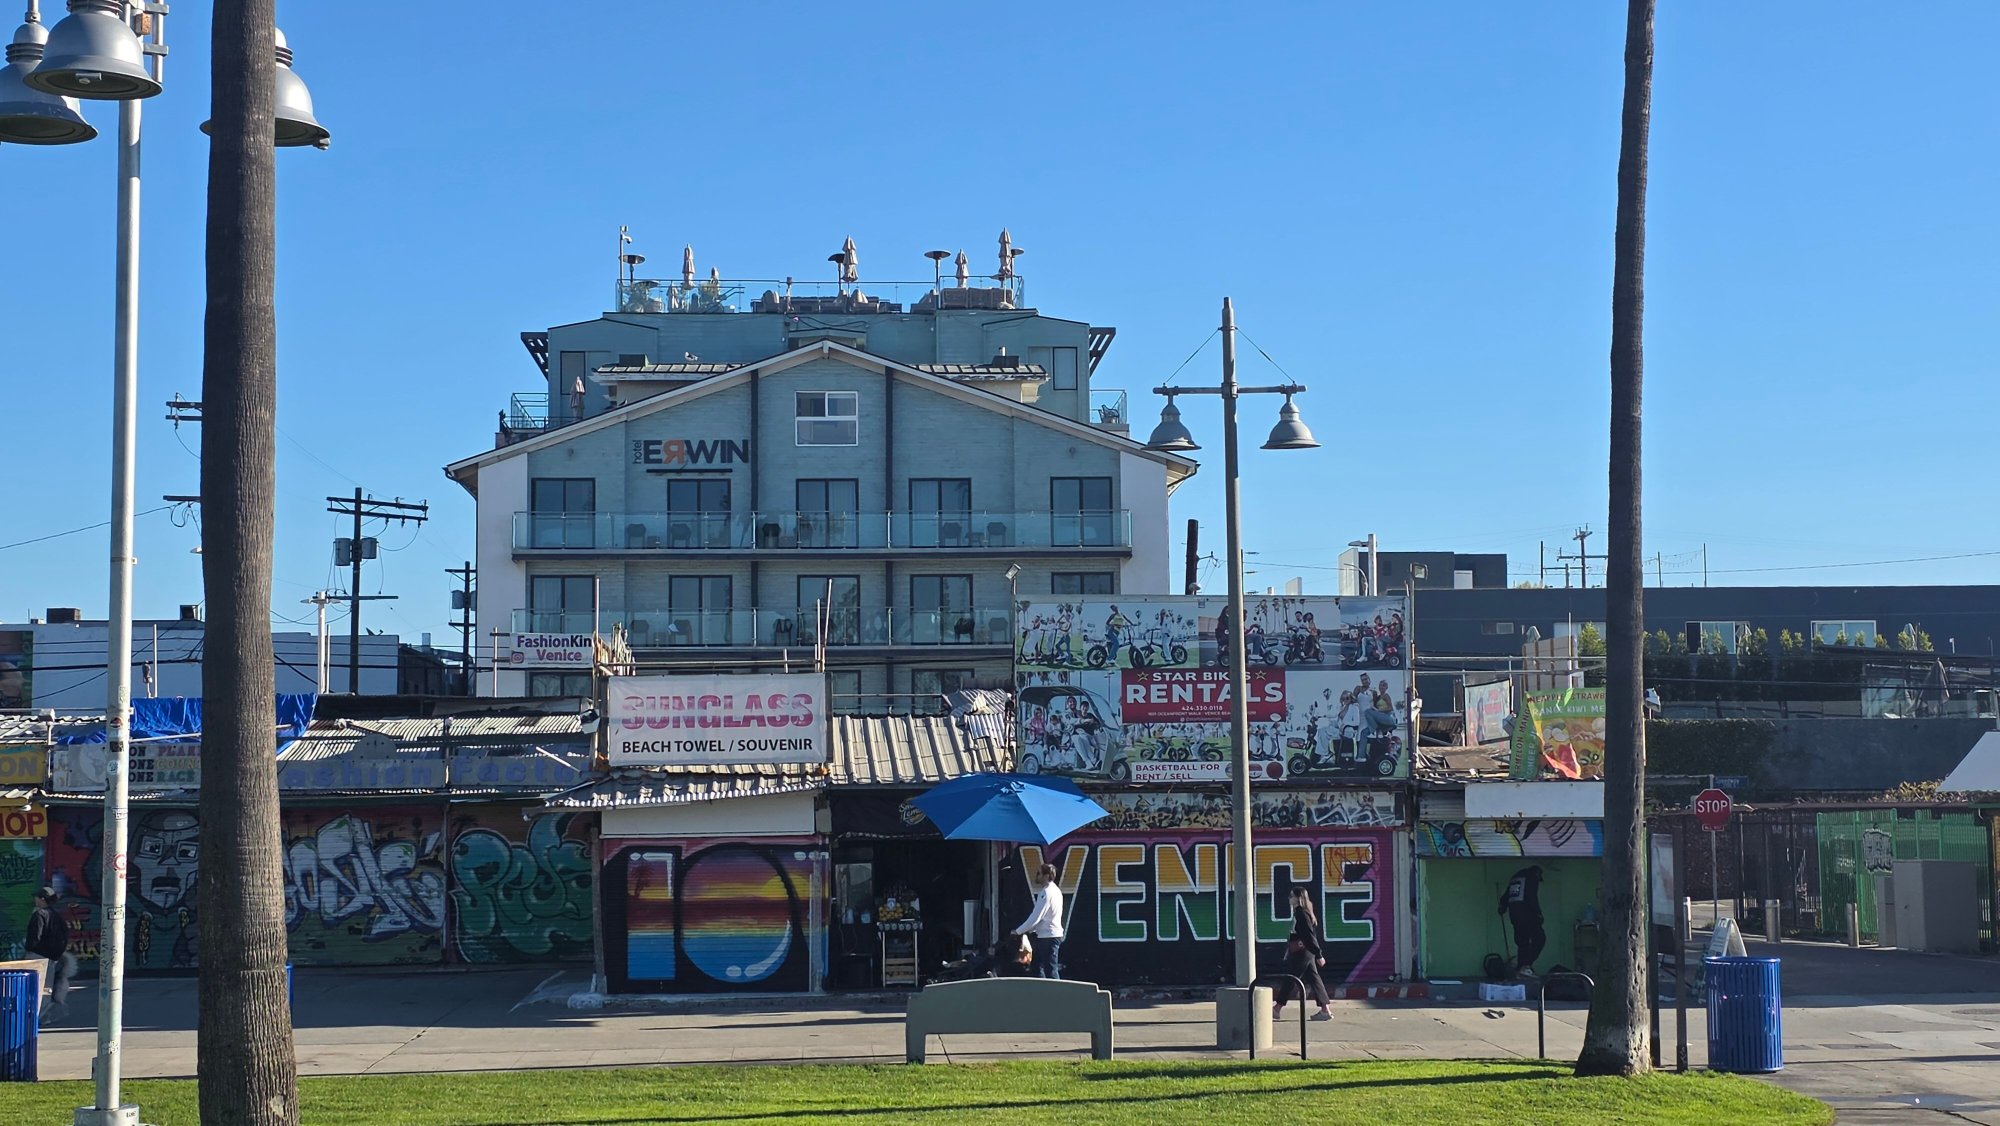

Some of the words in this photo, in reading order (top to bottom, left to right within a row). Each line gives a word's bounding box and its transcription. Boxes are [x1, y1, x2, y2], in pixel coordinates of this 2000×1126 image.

[632, 440, 643, 464] hotel
[536, 649, 582, 662] Venice
[1152, 672, 1197, 681] STAR
[1203, 672, 1251, 681] BIKS
[1126, 683, 1284, 704] RENTALS
[621, 694, 814, 729] SUNGLASS
[1567, 705, 1587, 713] KIWI
[158, 745, 201, 757] PLAN
[622, 741, 671, 753] BEACH
[674, 740, 726, 752] TOWEL
[738, 738, 813, 752] SOUVENIR
[129, 759, 154, 770] ONE
[129, 771, 154, 782] ONE
[156, 771, 195, 782] RACE
[282, 764, 433, 787] ashion
[452, 757, 591, 783] Facto
[1697, 800, 1728, 813] STOP
[0, 812, 44, 836] OP
